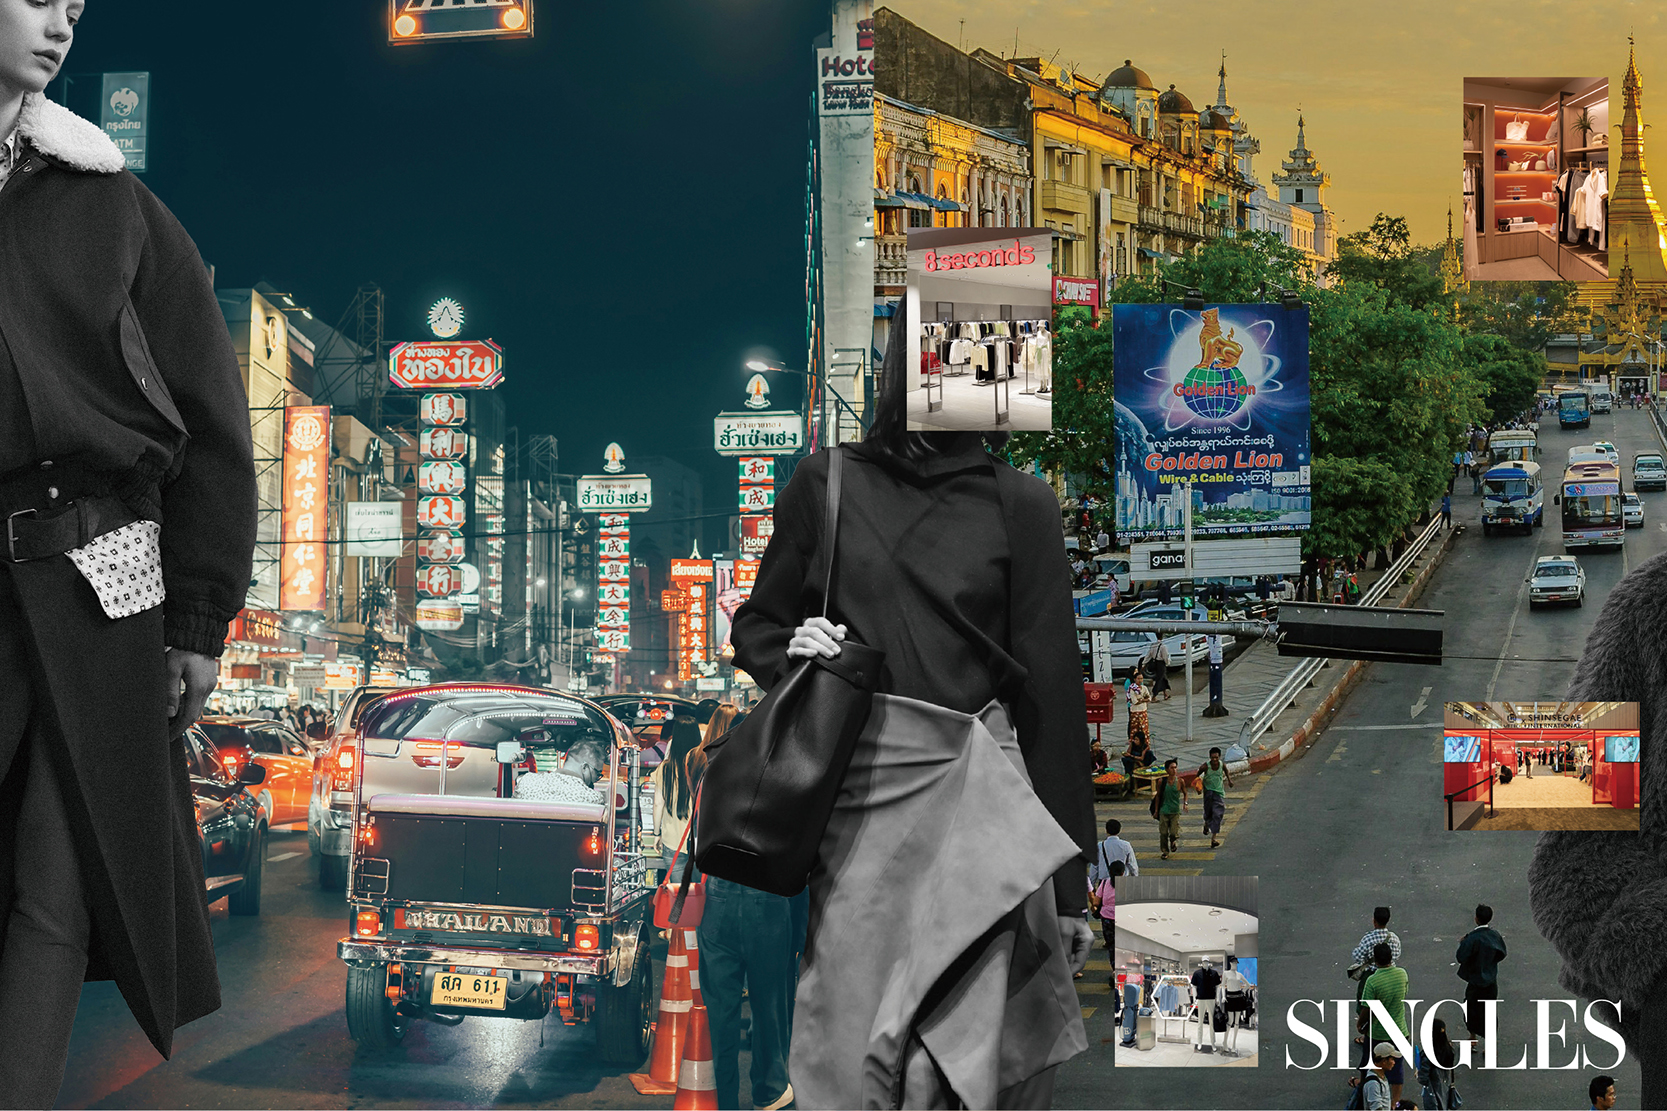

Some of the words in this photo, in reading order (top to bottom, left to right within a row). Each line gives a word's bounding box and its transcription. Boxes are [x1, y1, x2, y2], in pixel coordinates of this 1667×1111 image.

[106, 119, 141, 132] กรุงไทย
[925, 251, 938, 272] 8
[940, 241, 1035, 271] seconds
[402, 347, 492, 381] ทองใบ
[1173, 381, 1224, 397] Golden
[1227, 380, 1256, 396] Lion
[1191, 426, 1212, 435] Since
[1213, 426, 1231, 434] 1996
[1145, 452, 1228, 471] Golden
[1234, 450, 1283, 469] Lion
[1159, 474, 1188, 484] Wire
[1189, 473, 1199, 484] &
[1200, 472, 1235, 482] Cable
[292, 453, 317, 596] 北京同仁堂
[743, 536, 769, 547] Hotel
[1152, 553, 1185, 566] gana
[1528, 714, 1582, 722] SHINSEGAE
[405, 911, 552, 936] THAILAND
[473, 979, 498, 993] 611
